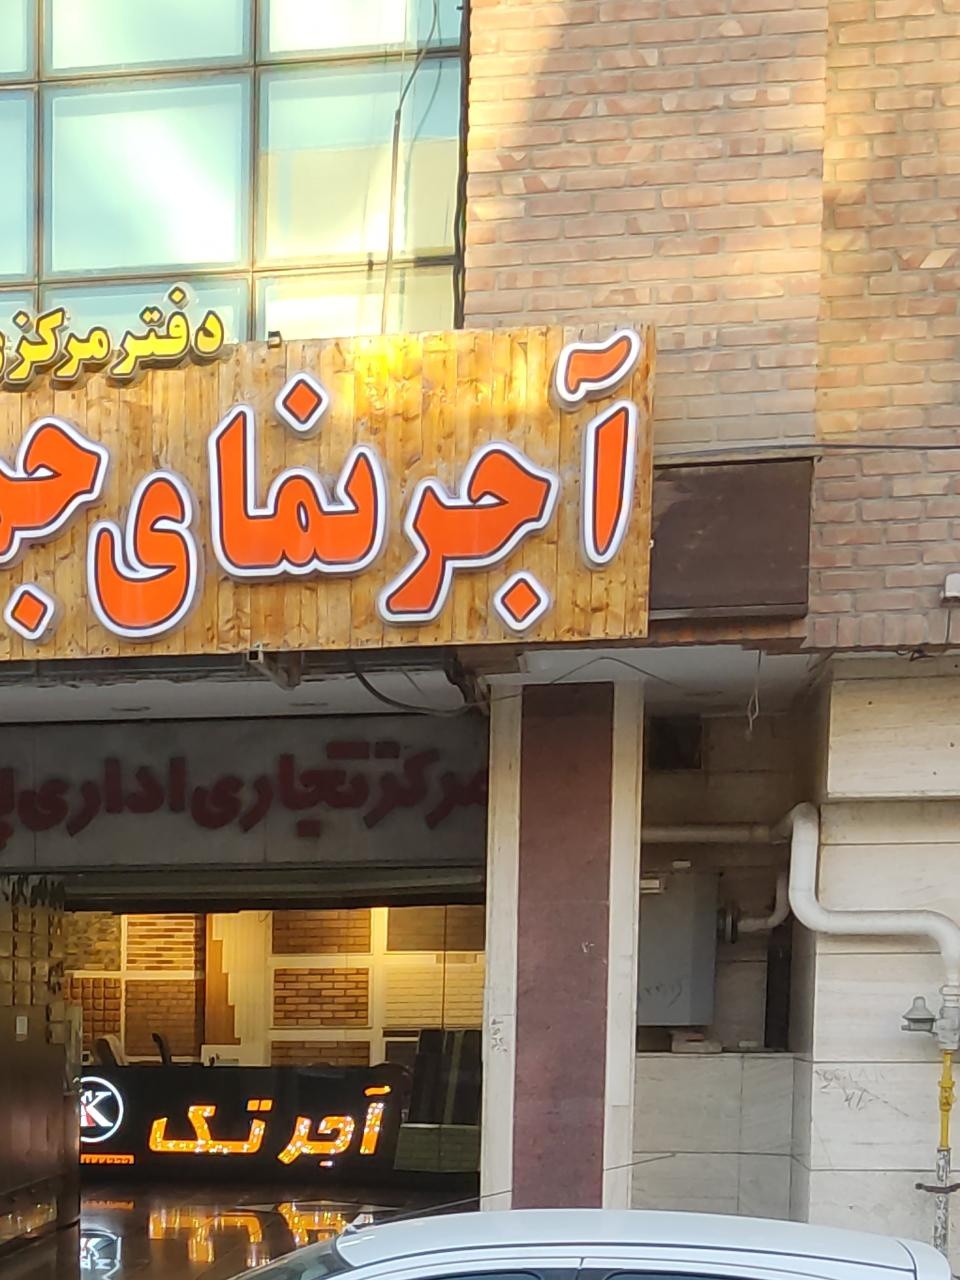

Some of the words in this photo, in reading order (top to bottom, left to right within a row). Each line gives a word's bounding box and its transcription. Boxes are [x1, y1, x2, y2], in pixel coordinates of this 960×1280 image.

[111, 283, 226, 379] دفتر
[87, 370, 387, 638] نمای
[378, 328, 640, 634] آجر
[17, 755, 187, 838] اداری
[191, 741, 370, 839] تجاری
[149, 1099, 273, 1154] تک
[277, 1085, 391, 1166] آجر
